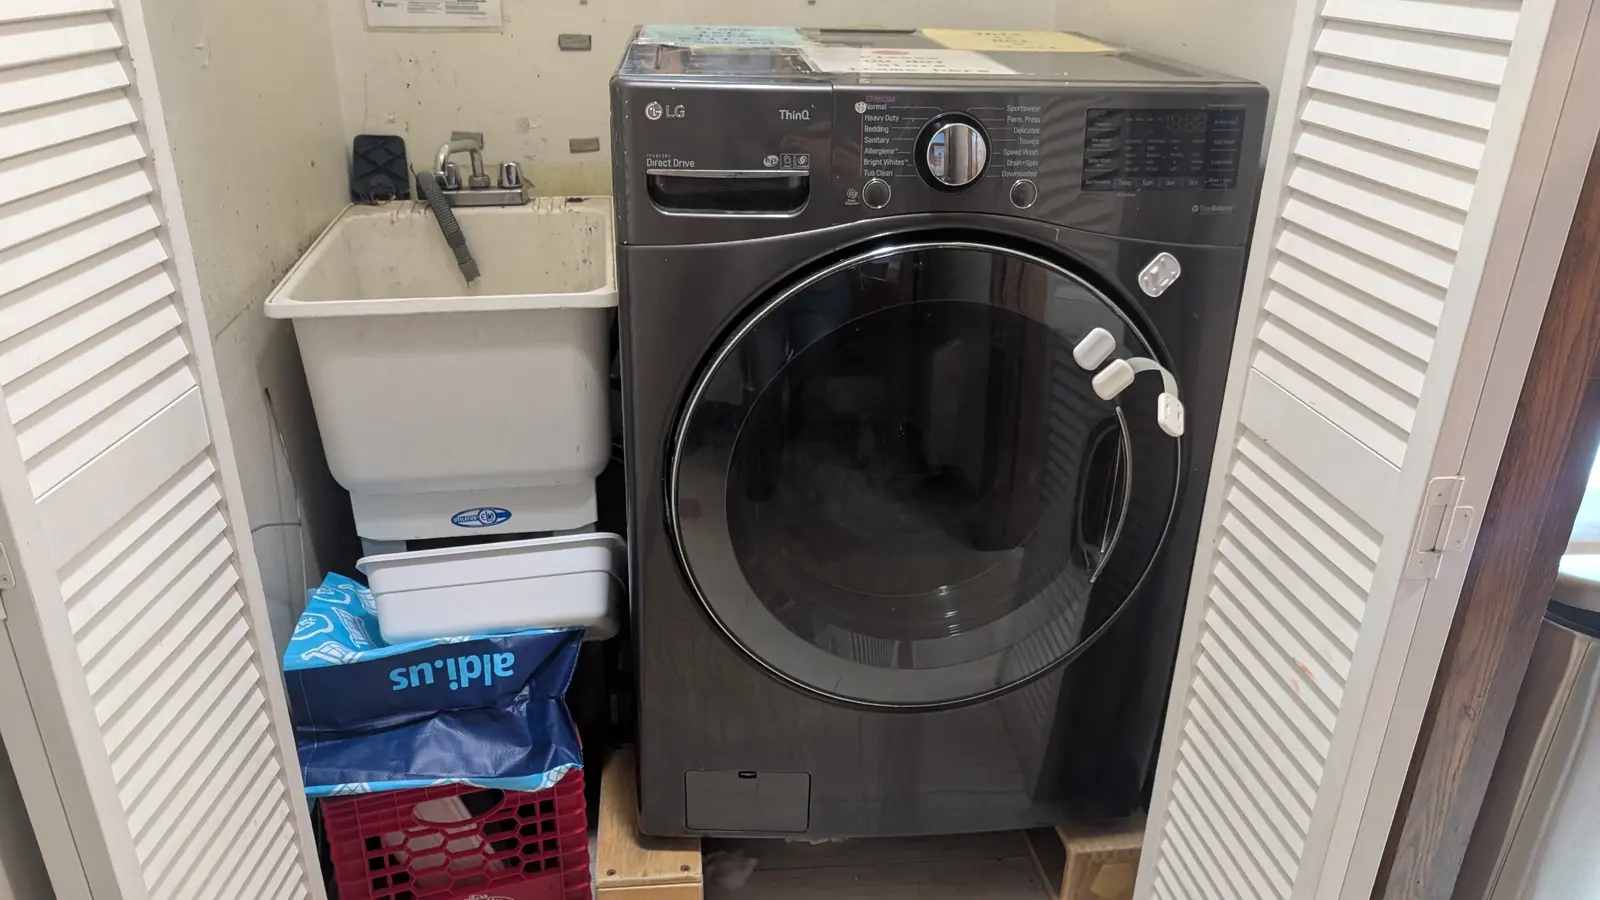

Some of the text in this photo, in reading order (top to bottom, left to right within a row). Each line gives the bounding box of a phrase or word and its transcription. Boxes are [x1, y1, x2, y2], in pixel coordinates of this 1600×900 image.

[665, 104, 686, 119] LG
[1006, 104, 1042, 112] Sportswear
[778, 109, 811, 121] ThinQ
[864, 114, 899, 123] Heavy Duty
[864, 125, 889, 133] Bedding
[864, 136, 890, 144] Sanitary
[1003, 148, 1021, 156] Speed
[646, 158, 695, 168] Direct Drive
[863, 158, 882, 167] Bright
[876, 169, 893, 177] Clean
[1002, 170, 1038, 178] Downloaded
[389, 652, 516, 691] aldi.us
